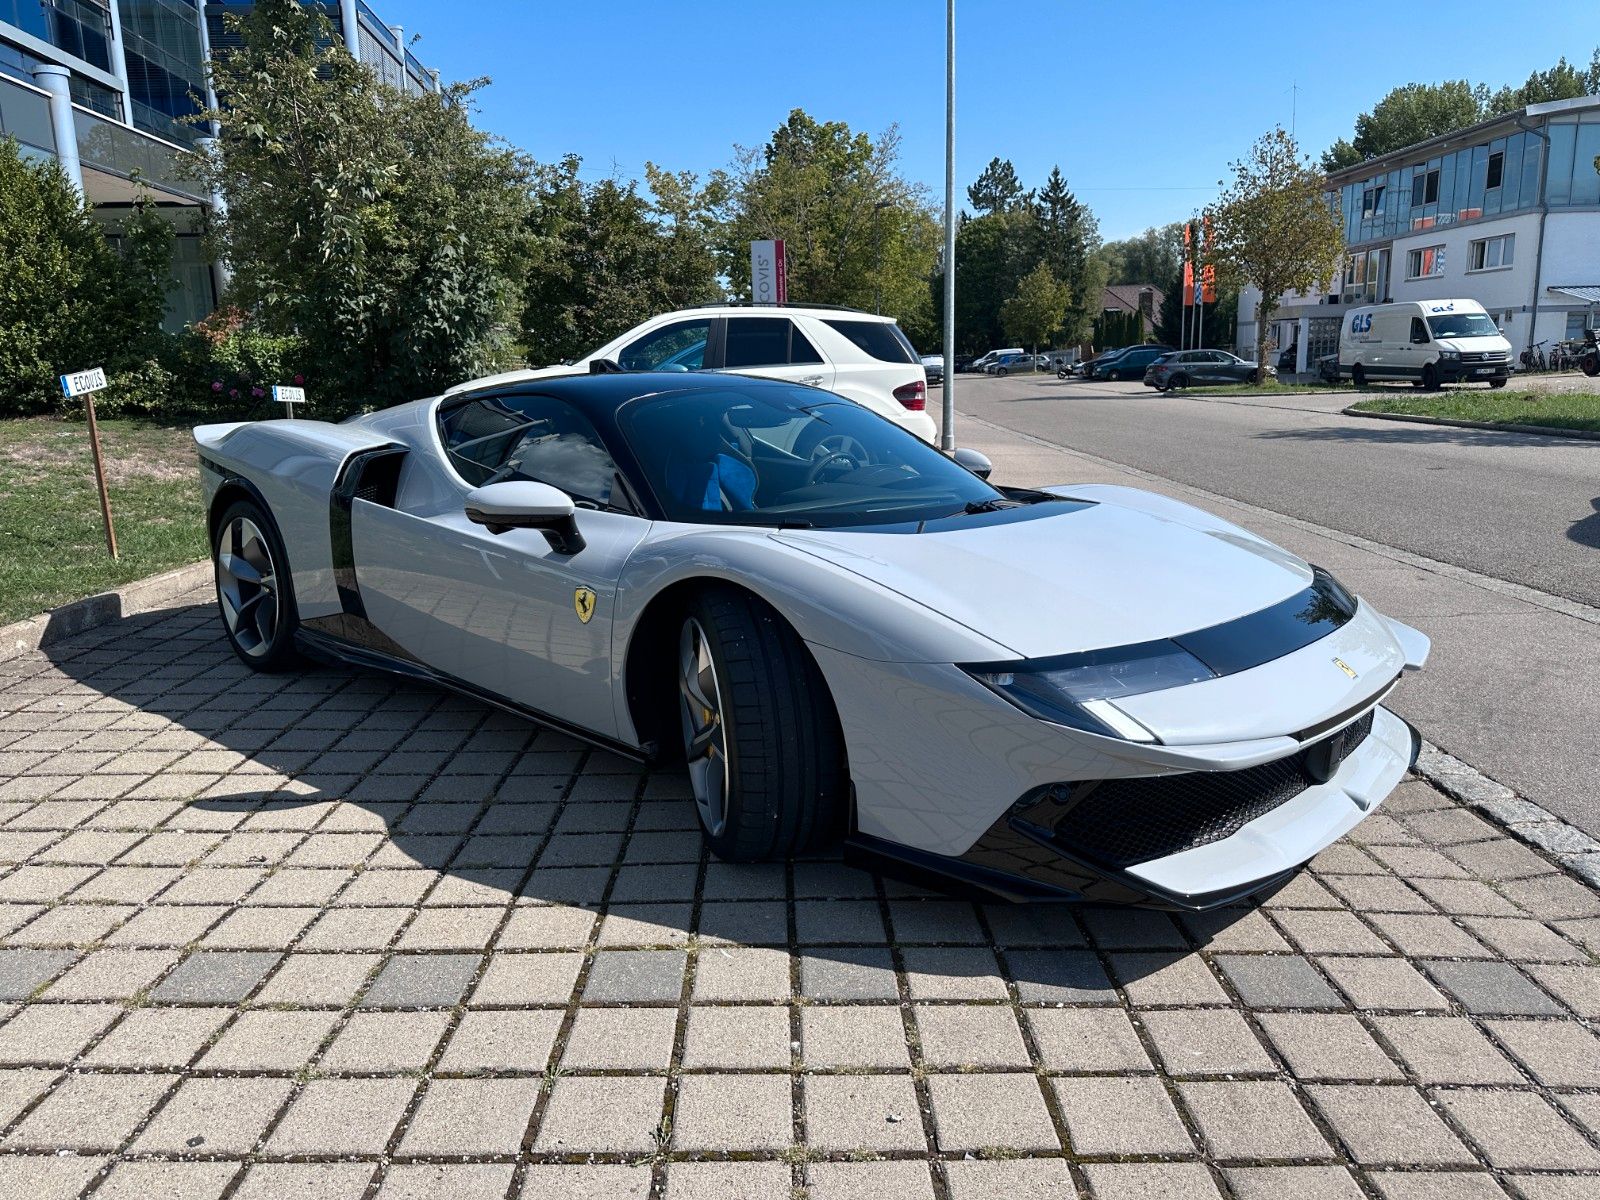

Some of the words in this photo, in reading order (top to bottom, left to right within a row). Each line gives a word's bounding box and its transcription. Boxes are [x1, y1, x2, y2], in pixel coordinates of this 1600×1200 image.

[1431, 304, 1454, 313] GLS
[1351, 313, 1373, 334] GLS
[73, 371, 103, 392] ECOVIS
